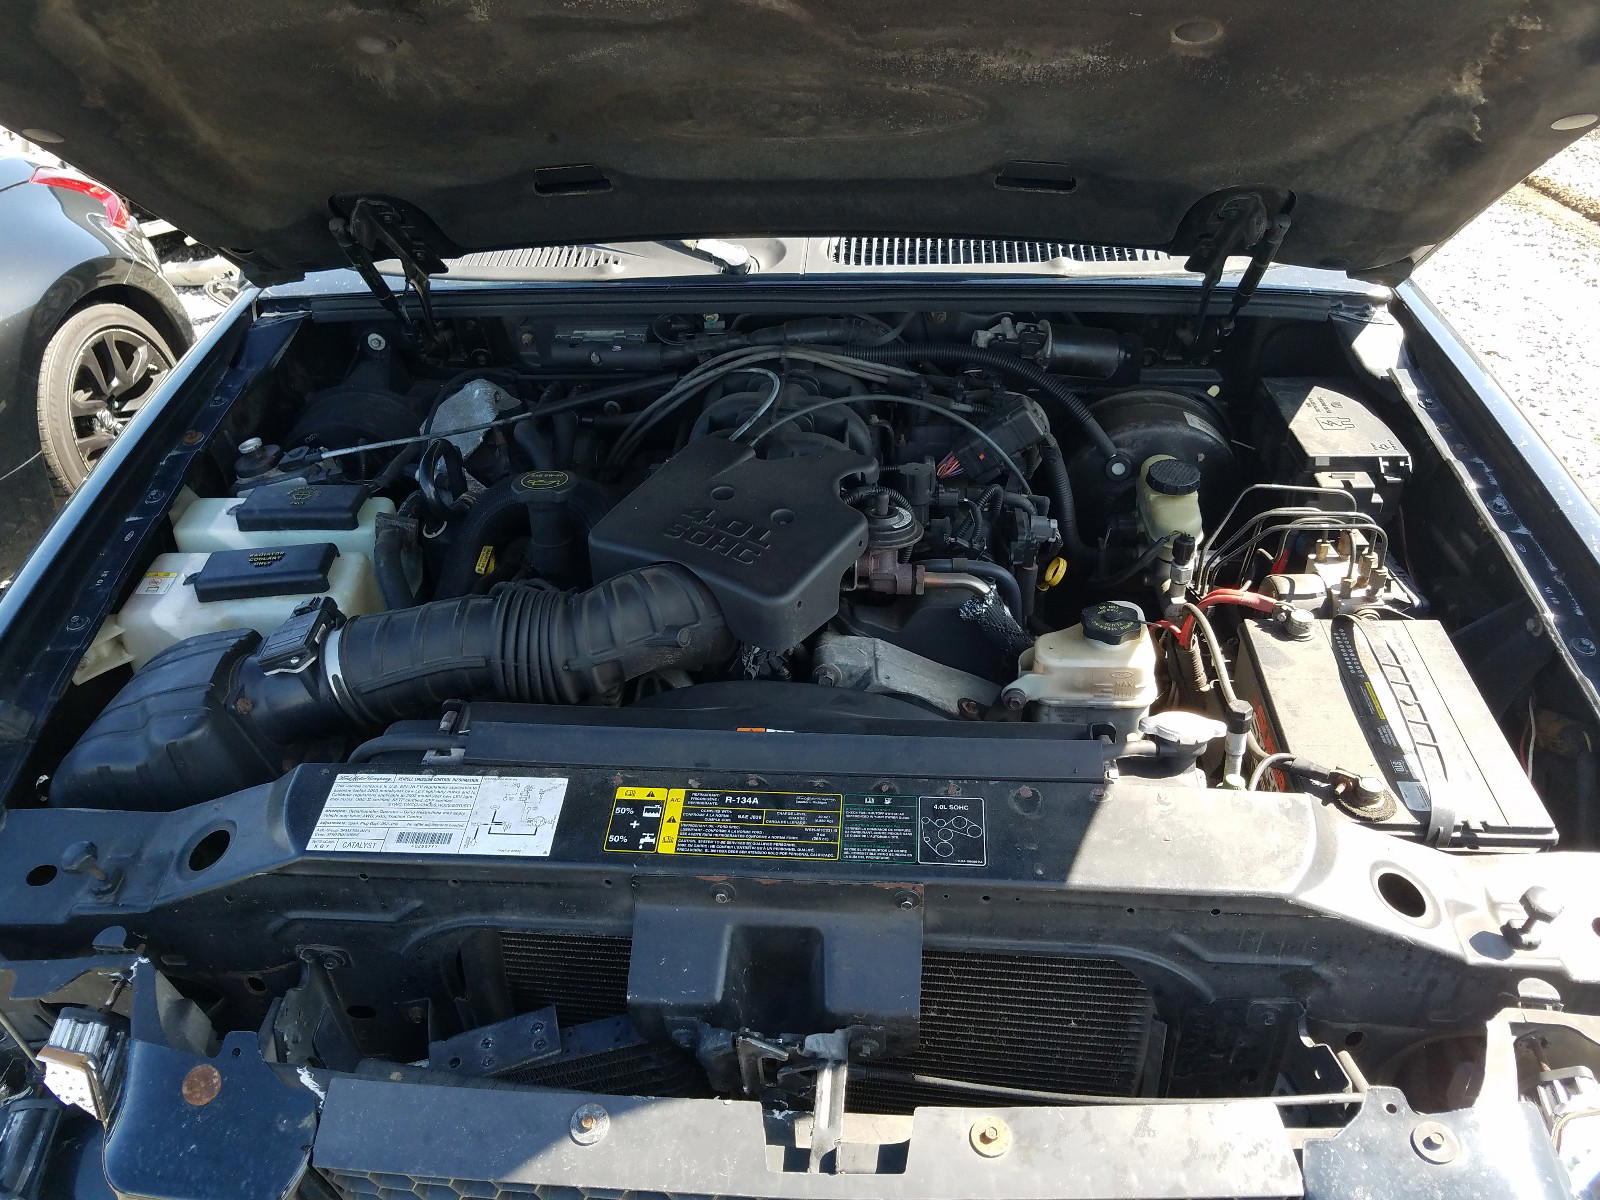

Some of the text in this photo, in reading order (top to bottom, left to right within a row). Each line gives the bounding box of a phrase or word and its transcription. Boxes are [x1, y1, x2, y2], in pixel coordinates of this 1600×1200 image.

[663, 523, 762, 565] SOHC
[725, 796, 759, 805] R-134A
[615, 807, 634, 815] 50%
[608, 835, 628, 843] 50%
[342, 841, 377, 849] CATALYST
